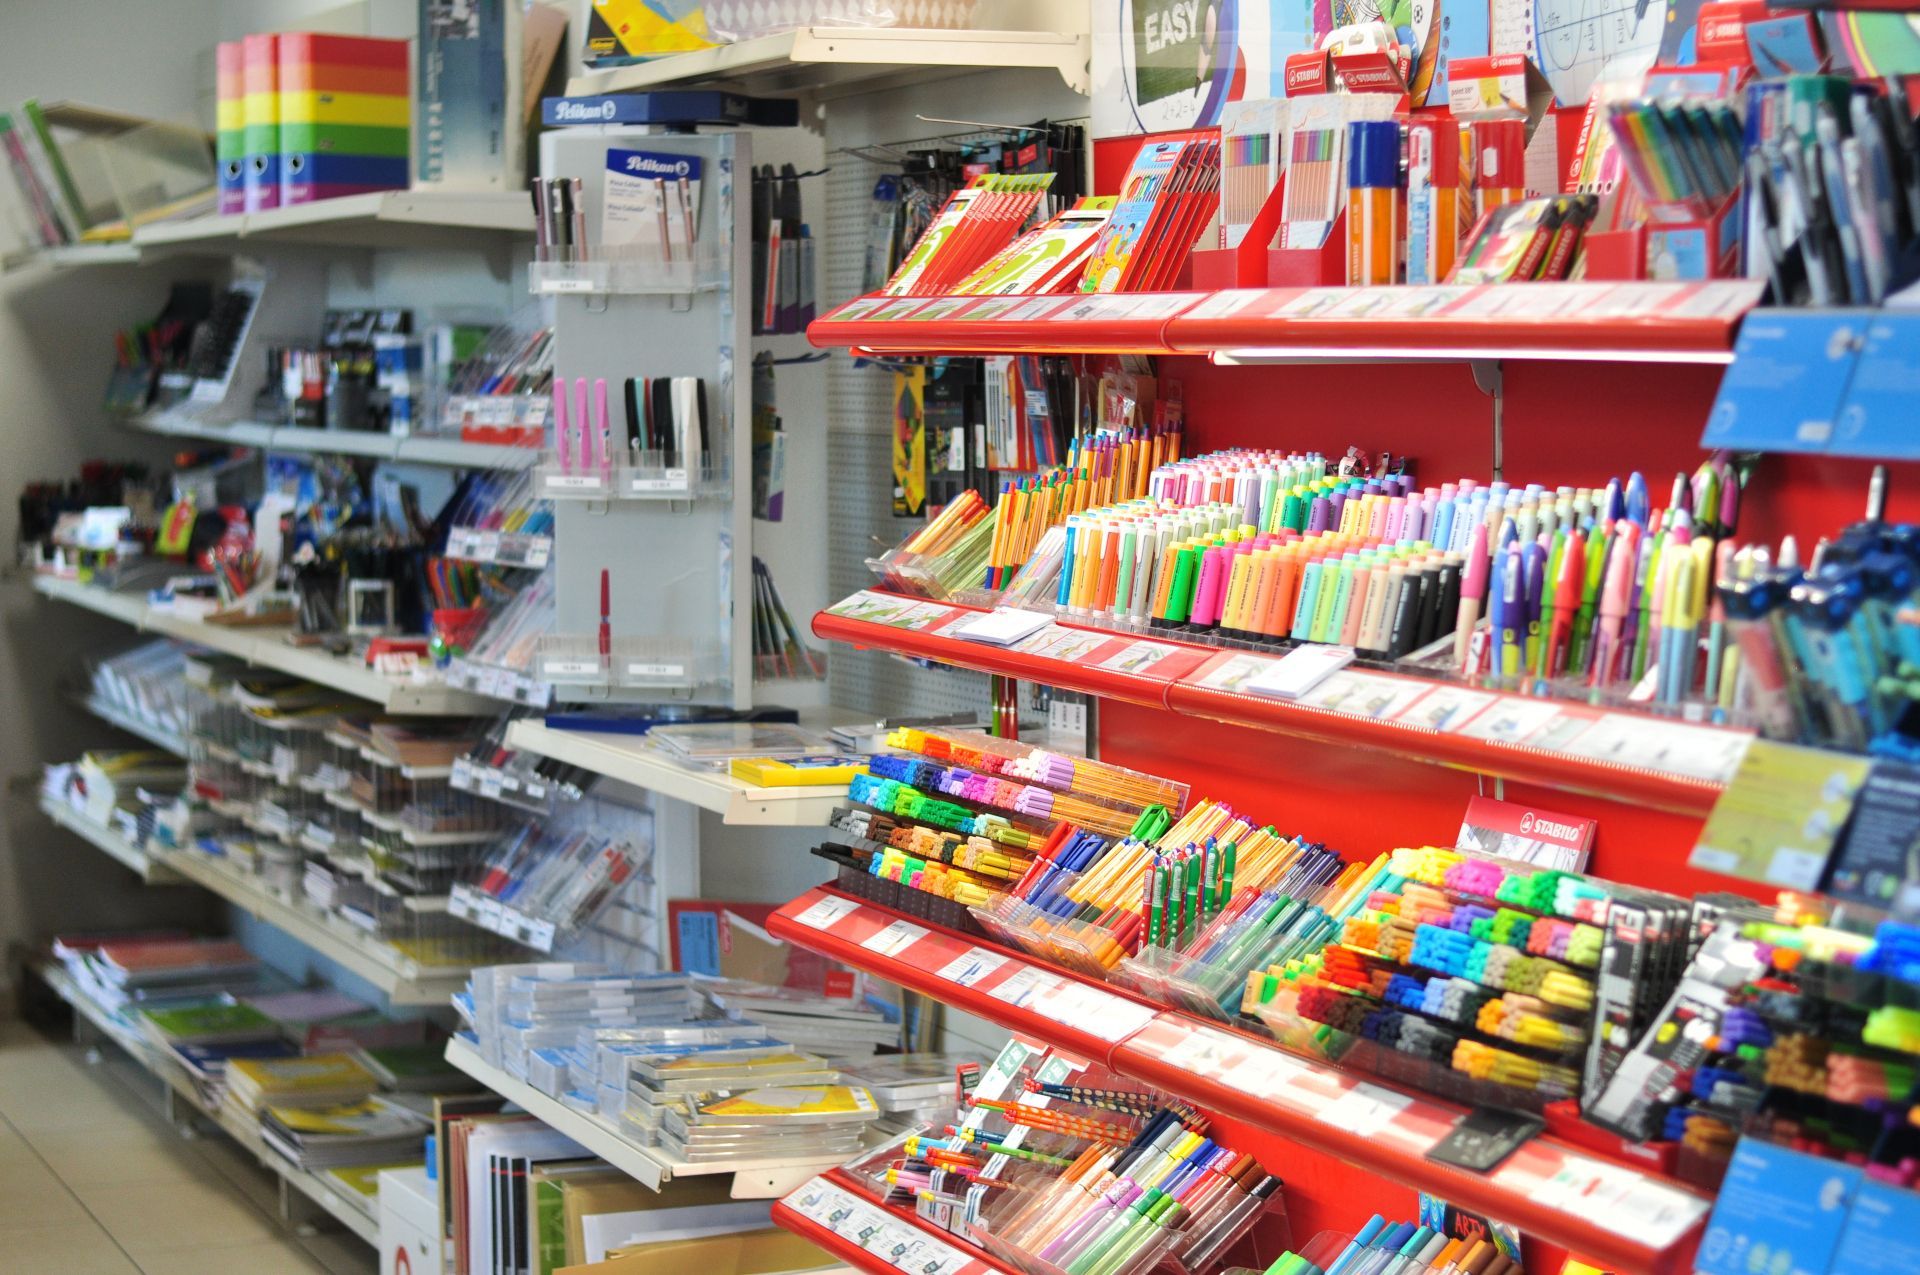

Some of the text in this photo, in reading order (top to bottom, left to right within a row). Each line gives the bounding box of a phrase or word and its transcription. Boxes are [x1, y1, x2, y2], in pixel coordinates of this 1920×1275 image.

[1144, 0, 1199, 55] EASY
[1296, 68, 1320, 82] STABILO
[555, 101, 602, 120] Pelikan
[626, 155, 676, 174] Pelikan
[1518, 231, 1548, 276] STABILO
[1533, 819, 1580, 842] STABILO
